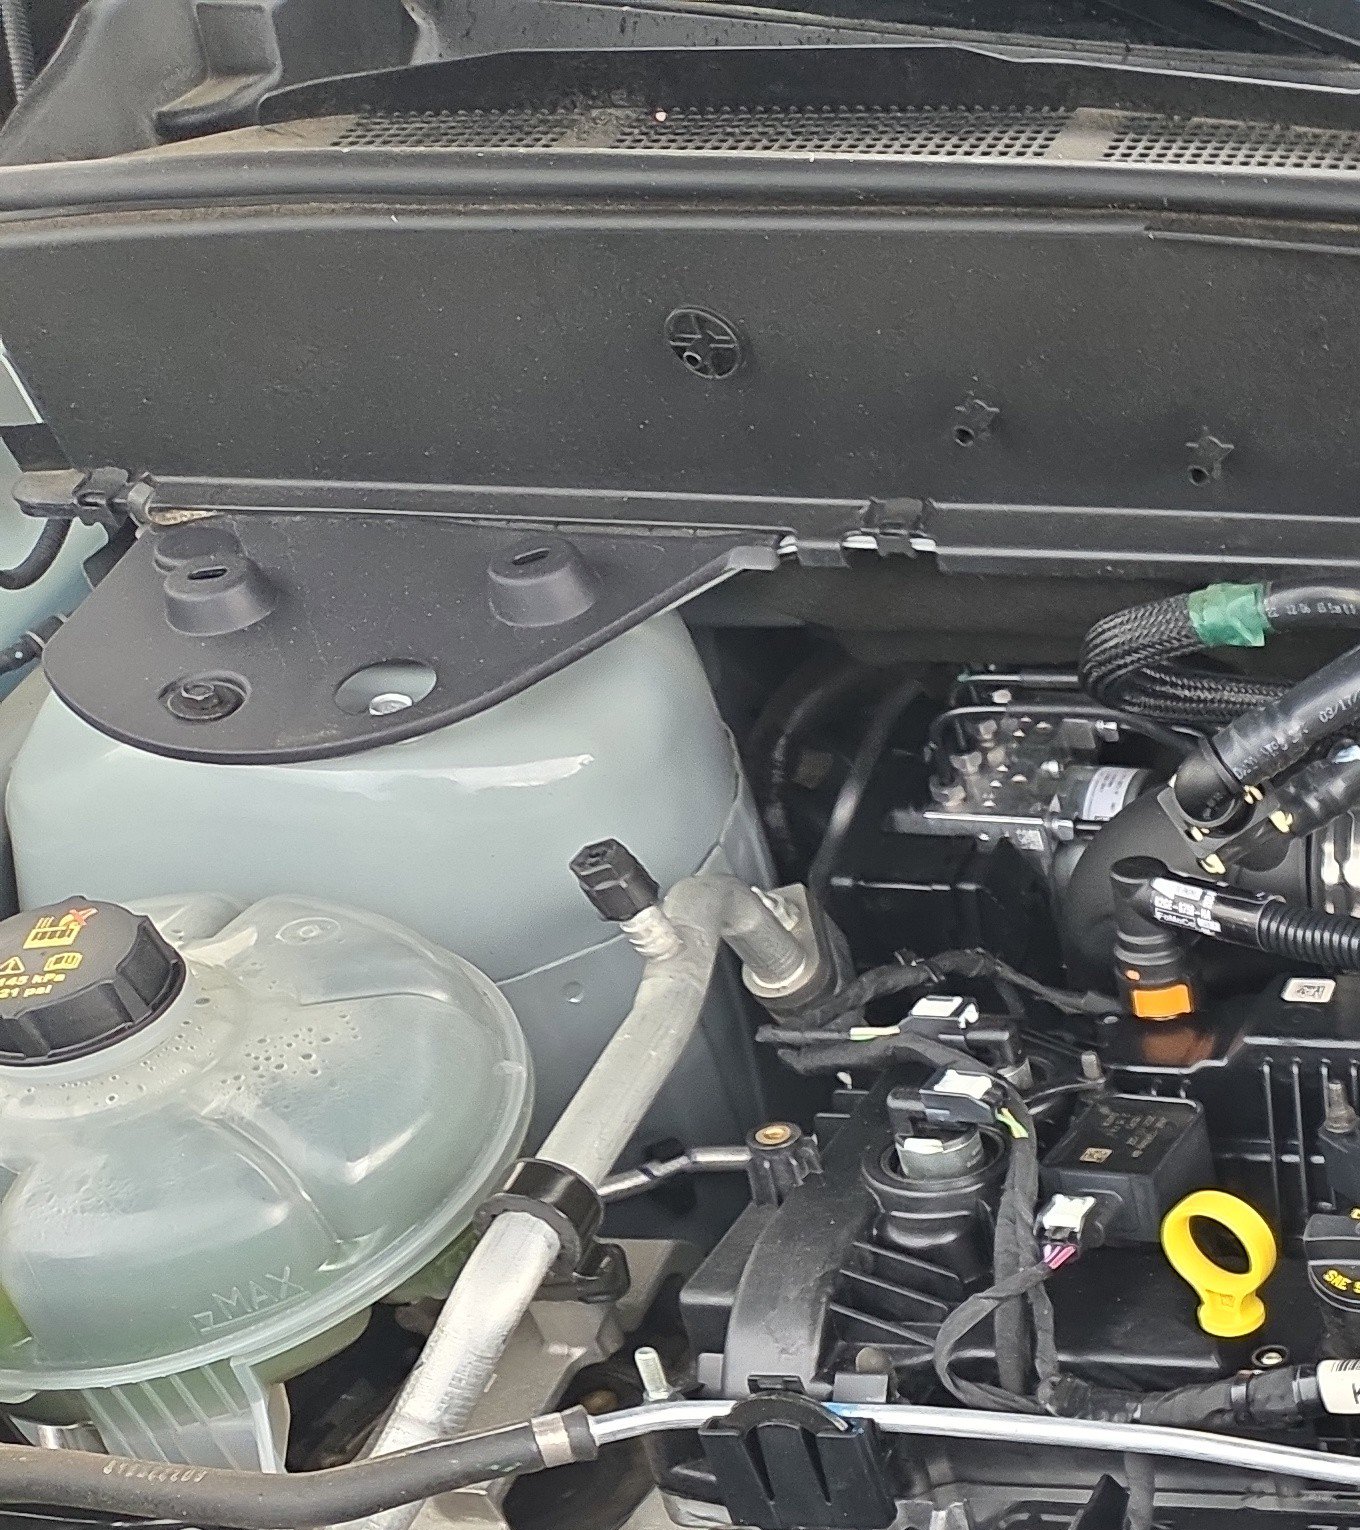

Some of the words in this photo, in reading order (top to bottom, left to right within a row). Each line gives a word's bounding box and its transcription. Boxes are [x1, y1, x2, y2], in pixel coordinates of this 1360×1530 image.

[32, 973, 66, 985] kPa
[1322, 1269, 1352, 1291] SAE
[211, 1266, 305, 1319] MAX
